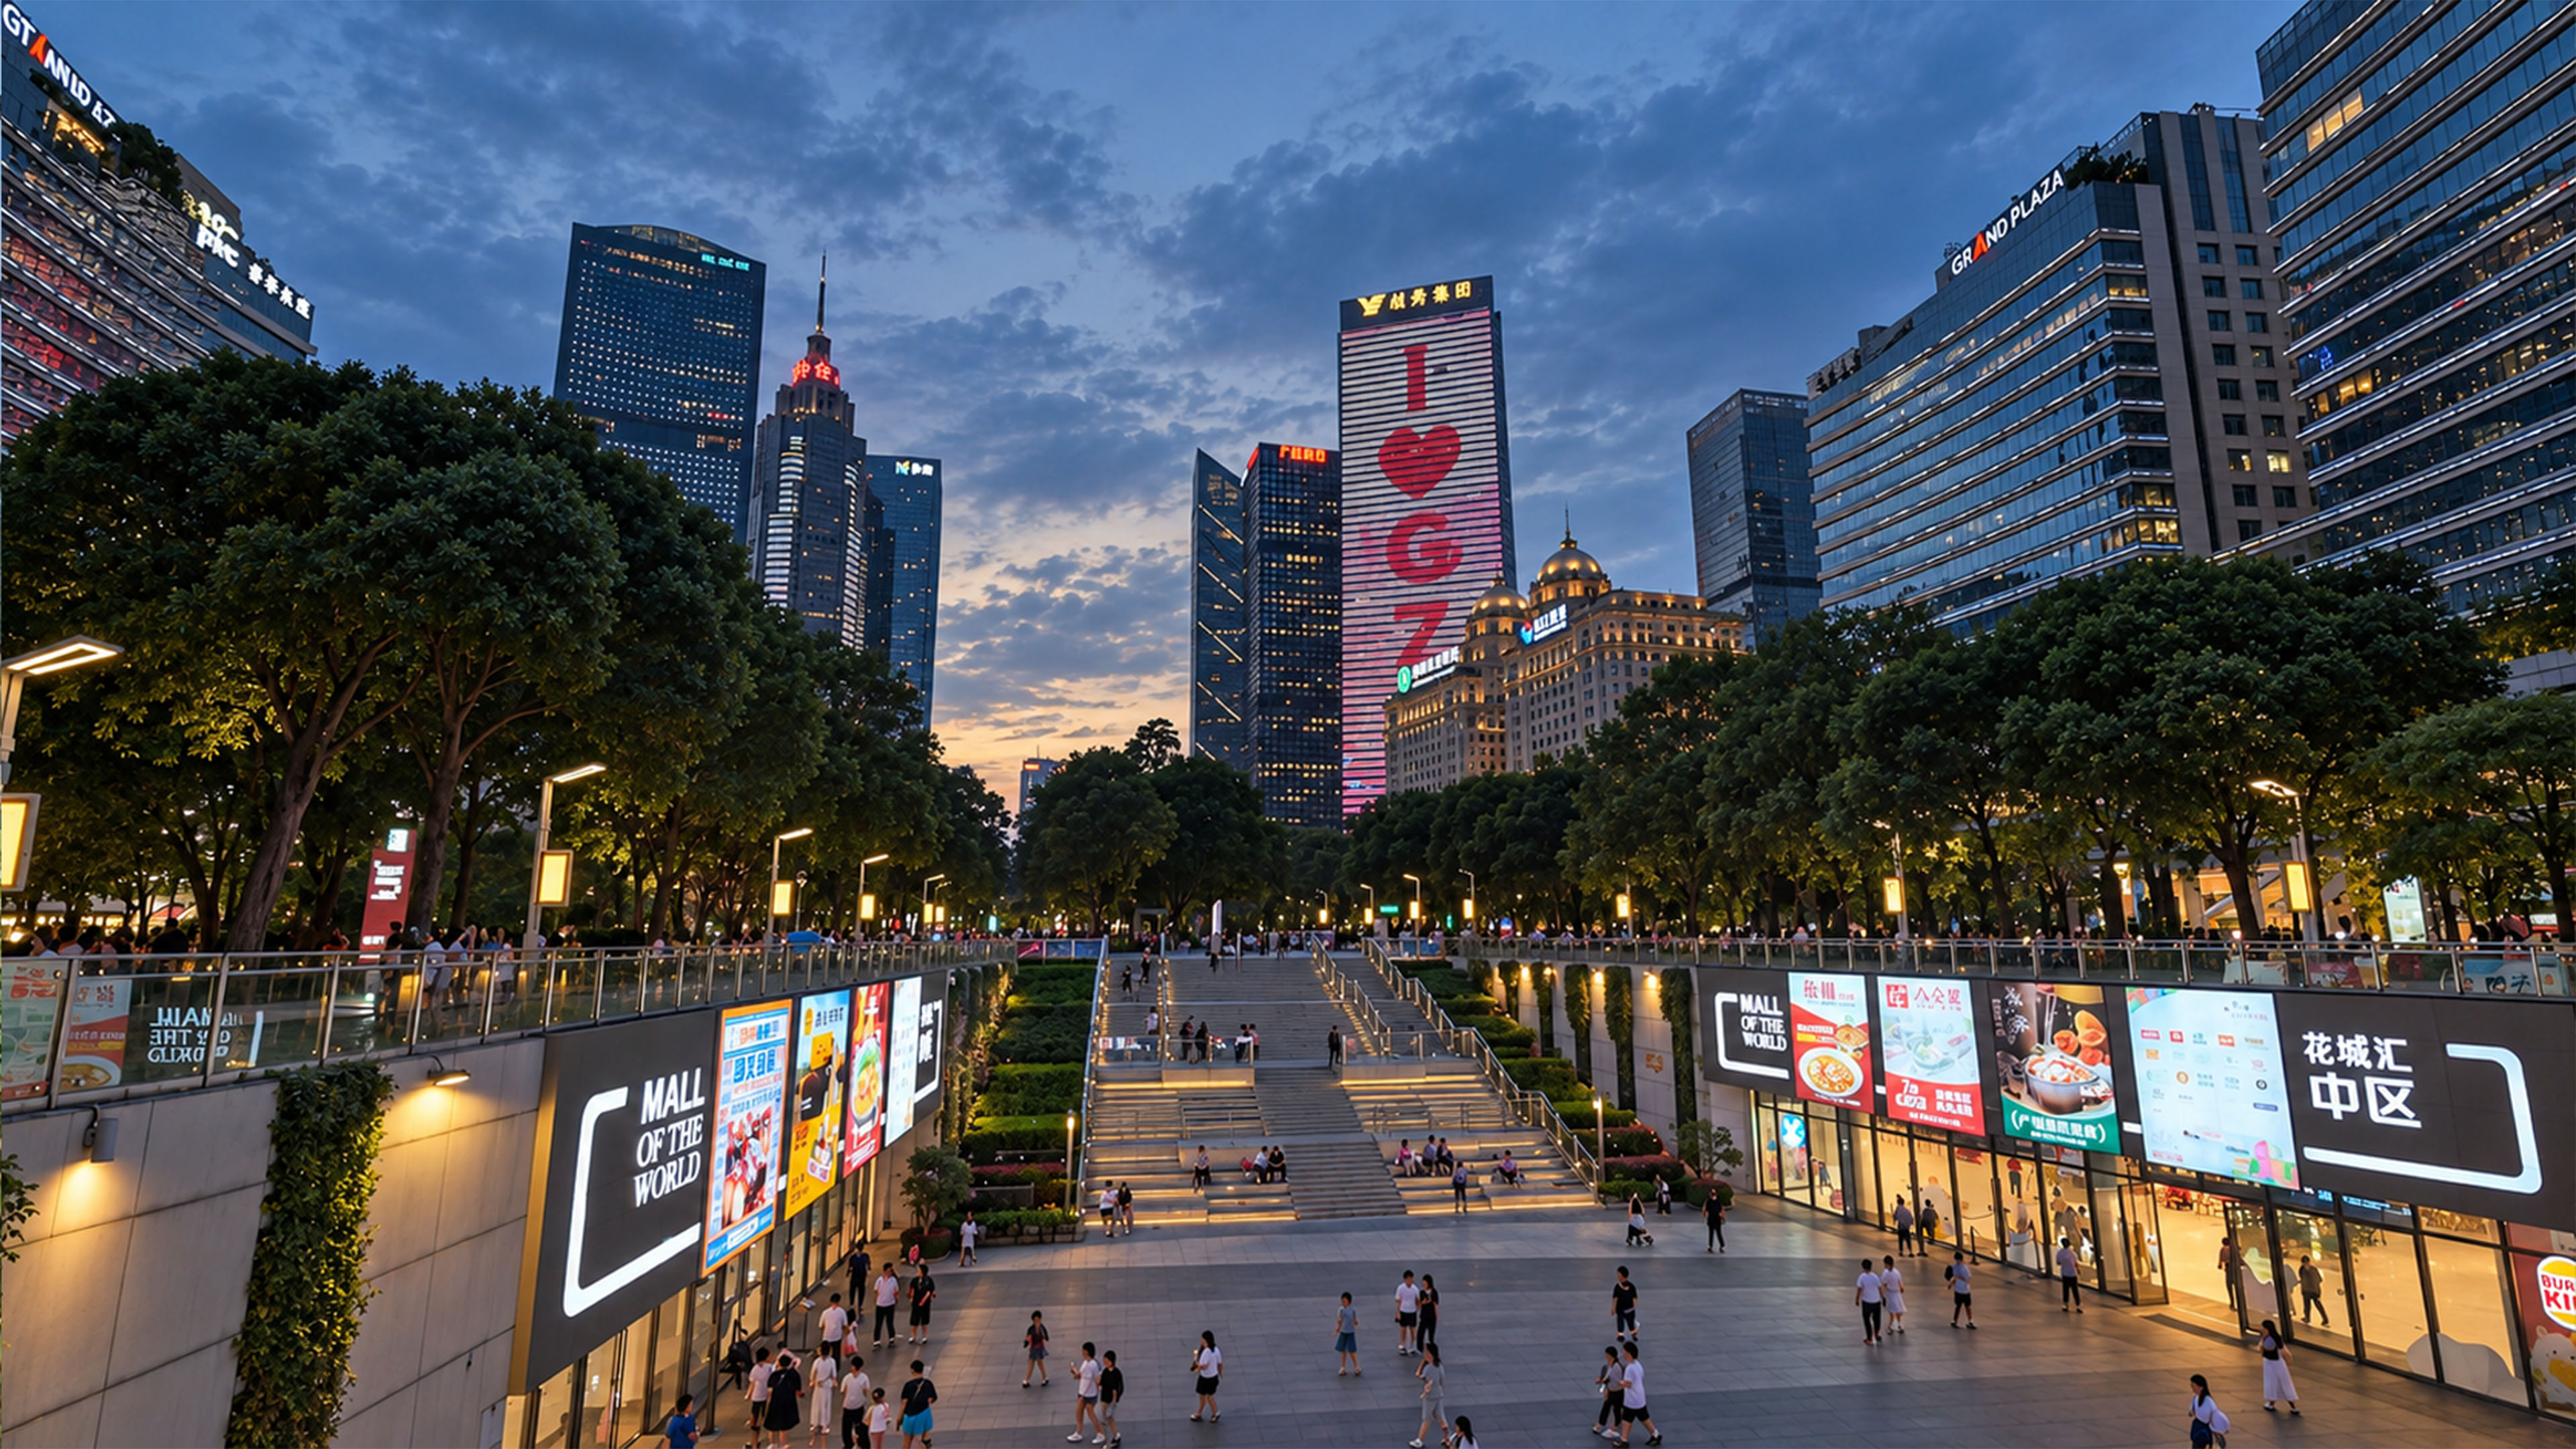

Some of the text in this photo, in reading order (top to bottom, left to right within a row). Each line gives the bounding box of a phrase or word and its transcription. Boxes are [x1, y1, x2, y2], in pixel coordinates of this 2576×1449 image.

[1951, 169, 2064, 275] GRAND PLAZA
[1739, 994, 1784, 1016] MALL
[1741, 1015, 1757, 1031] OF
[1758, 1017, 1785, 1034] THE
[1742, 1032, 1787, 1052] WORLD
[2302, 1031, 2413, 1073] 花城汇
[641, 1067, 705, 1125] MALL
[2309, 1071, 2422, 1128] 中区
[637, 1113, 704, 1167] OF THE
[633, 1150, 701, 1208] WORLD
